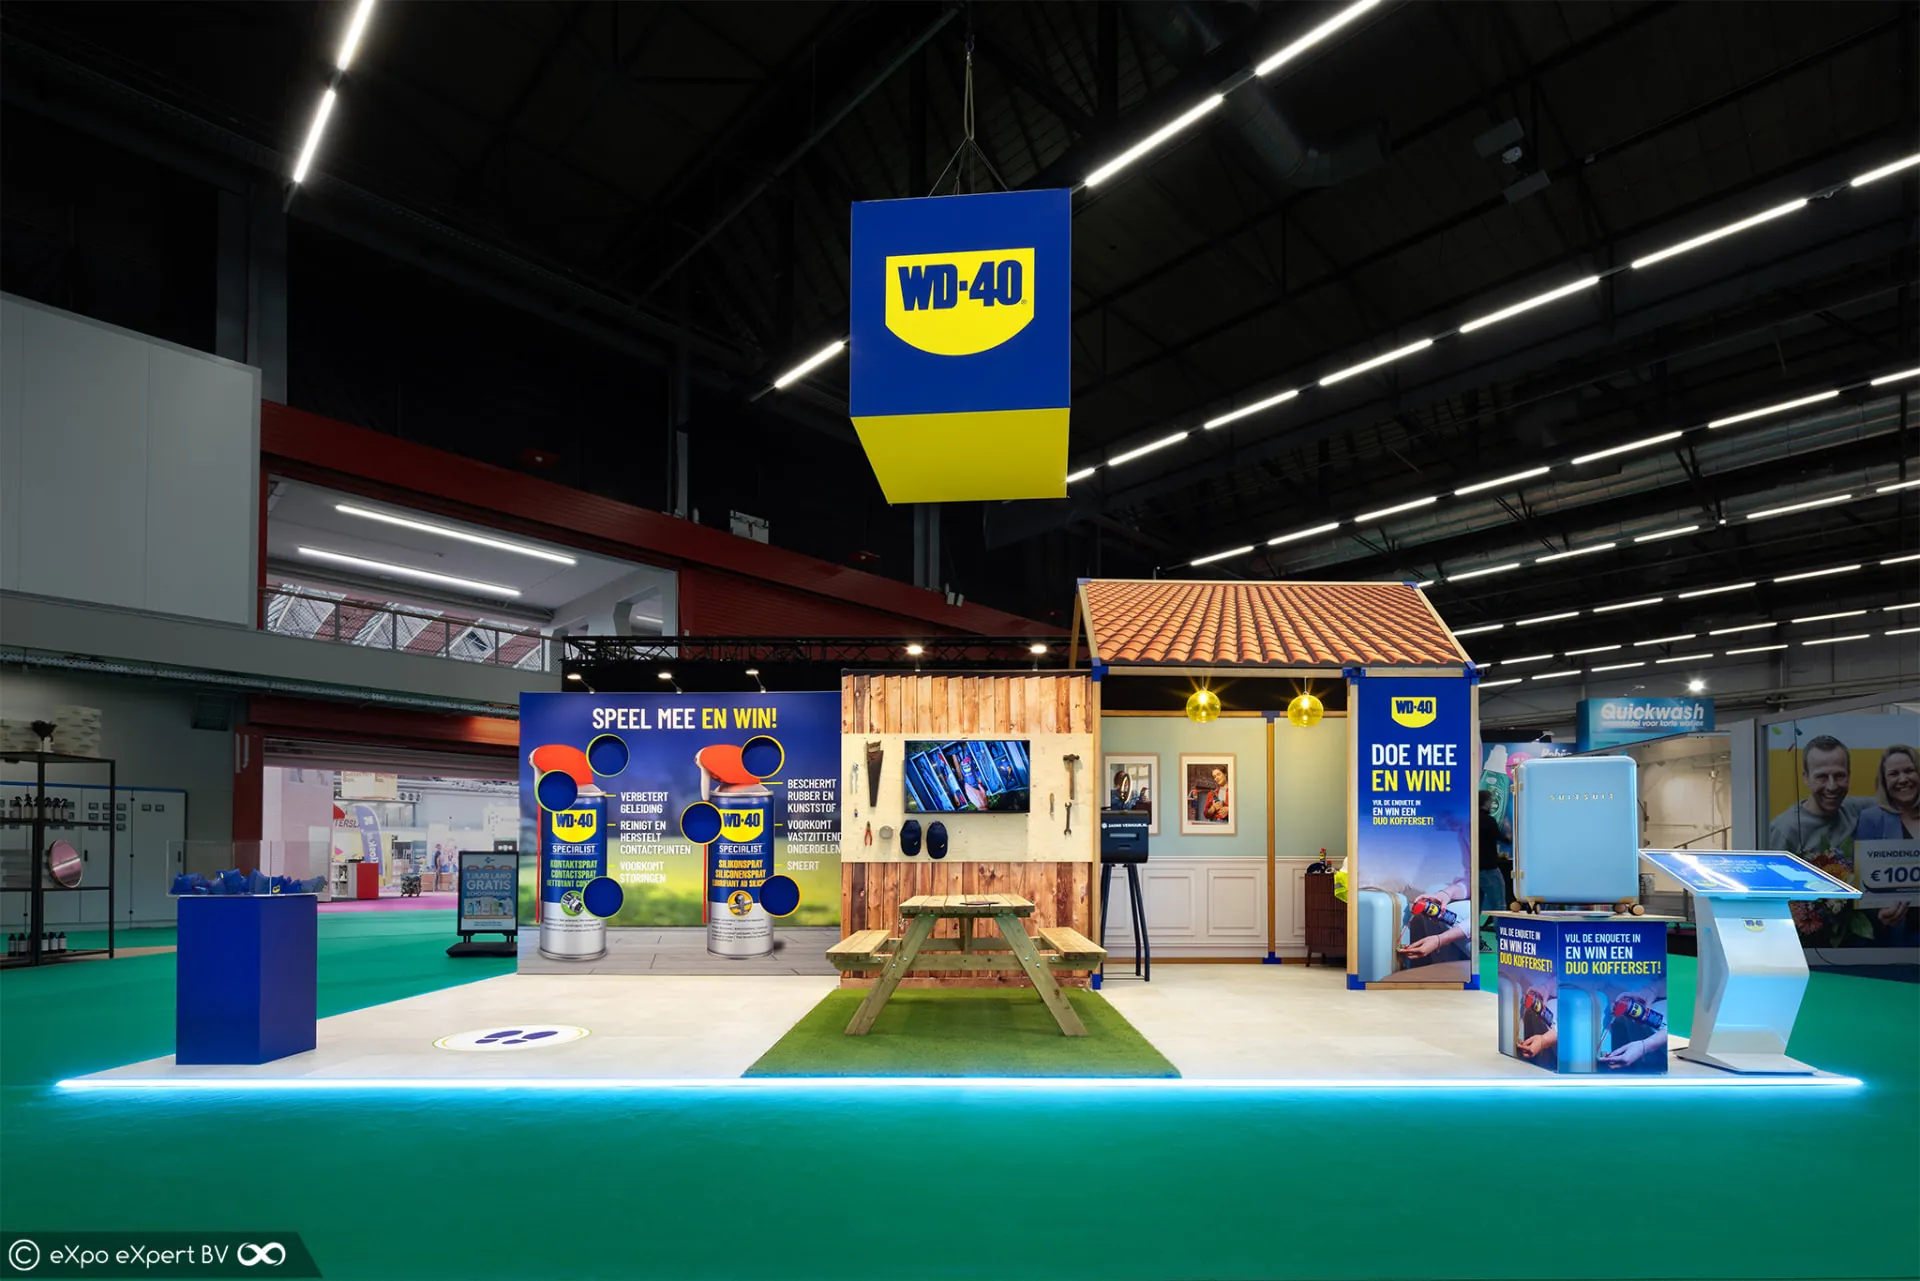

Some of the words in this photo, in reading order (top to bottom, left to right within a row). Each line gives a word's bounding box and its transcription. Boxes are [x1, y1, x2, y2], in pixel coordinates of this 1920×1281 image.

[1395, 700, 1433, 714] WD-40
[1601, 703, 1704, 720] Quickwash
[592, 707, 652, 730] SPEEL
[657, 707, 695, 730] MEE
[702, 707, 727, 729] EN
[733, 707, 777, 729] WIN!
[1372, 743, 1410, 766] DOE
[1417, 743, 1457, 766] MEE
[787, 778, 837, 789] BESCHERMT
[1372, 769, 1398, 792] EN
[1405, 769, 1451, 792] WIN!
[620, 791, 669, 802] VERBETERT
[787, 791, 821, 801] RUBBER
[822, 791, 834, 801] EN
[1549, 793, 1616, 801] SUITSUIT
[620, 803, 663, 814] GELEIDING
[787, 803, 837, 813] KUNSTSTOF
[1373, 807, 1383, 816] EN
[1385, 807, 1400, 816] WIN
[1401, 807, 1416, 816] EEN
[555, 813, 594, 828] WD-40
[620, 820, 653, 831] REINIGT
[654, 820, 667, 831] EN
[722, 813, 760, 828] WD-40
[787, 819, 833, 830] VOORKOMT
[1373, 816, 1388, 826] DUO
[1389, 816, 1434, 826] KOFFERSET!
[620, 832, 662, 843] HERSTELT
[552, 845, 596, 853] SPECIALIST
[620, 844, 691, 855] CONTACTPUNTEN
[719, 845, 763, 853] SPECIALIST
[787, 844, 841, 854] ONDERDELEN
[549, 859, 598, 869] KONTAKTSPRAY
[619, 861, 664, 871] VOORKOMT
[718, 859, 763, 869] SILIKONSPRAY
[787, 860, 820, 871] SMEERT
[551, 869, 597, 879] CONTACTSPRAY
[619, 873, 666, 883] STORINGEN
[715, 869, 767, 879] SILICONENSPRAY
[466, 879, 511, 890] GRATIS
[1499, 926, 1508, 936] VUL
[1508, 927, 1514, 937] DE
[1515, 928, 1535, 940] ENQUETE
[1535, 931, 1541, 940] IN
[1565, 933, 1580, 943] VUL
[1582, 933, 1593, 943] DE
[1595, 933, 1631, 944] ENQUETE
[1632, 933, 1641, 943] IN
[1499, 938, 1508, 951] EN
[1509, 939, 1522, 953] WIN
[1523, 941, 1537, 956] EEN
[1565, 946, 1581, 960] EN
[1584, 946, 1607, 960] WIN
[1610, 946, 1633, 960] EEN
[1499, 951, 1512, 965] DUO
[1513, 954, 1553, 973] KOFFERSET!
[1565, 961, 1589, 975] DUO
[1591, 961, 1662, 975] KOFFERSET!
